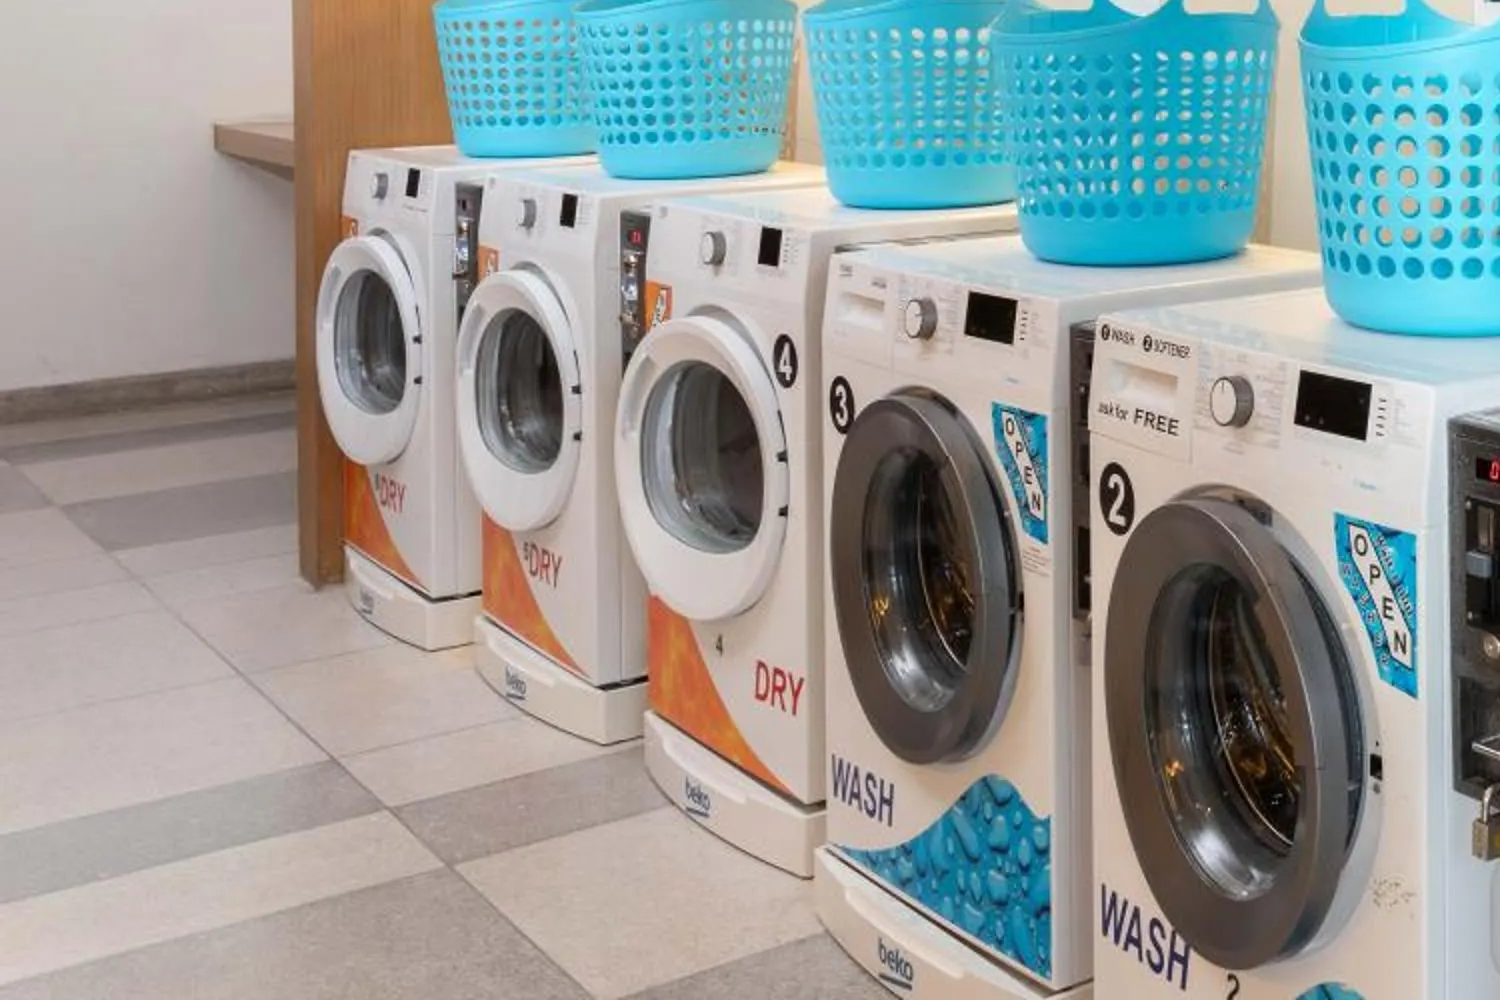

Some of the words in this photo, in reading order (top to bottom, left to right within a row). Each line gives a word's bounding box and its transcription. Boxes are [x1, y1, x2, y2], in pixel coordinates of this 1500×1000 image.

[834, 384, 849, 426] 3
[1134, 408, 1180, 436] FREE
[1005, 417, 1041, 512] OPEN
[380, 474, 406, 513] DRY
[1108, 473, 1127, 525] 2
[529, 543, 562, 589] DRY
[1354, 534, 1406, 654] OPEN
[715, 634, 724, 656] 4
[755, 661, 804, 716] DRY
[831, 754, 894, 827] WASH
[879, 938, 913, 981] beko
[1101, 883, 1191, 991] WASH
